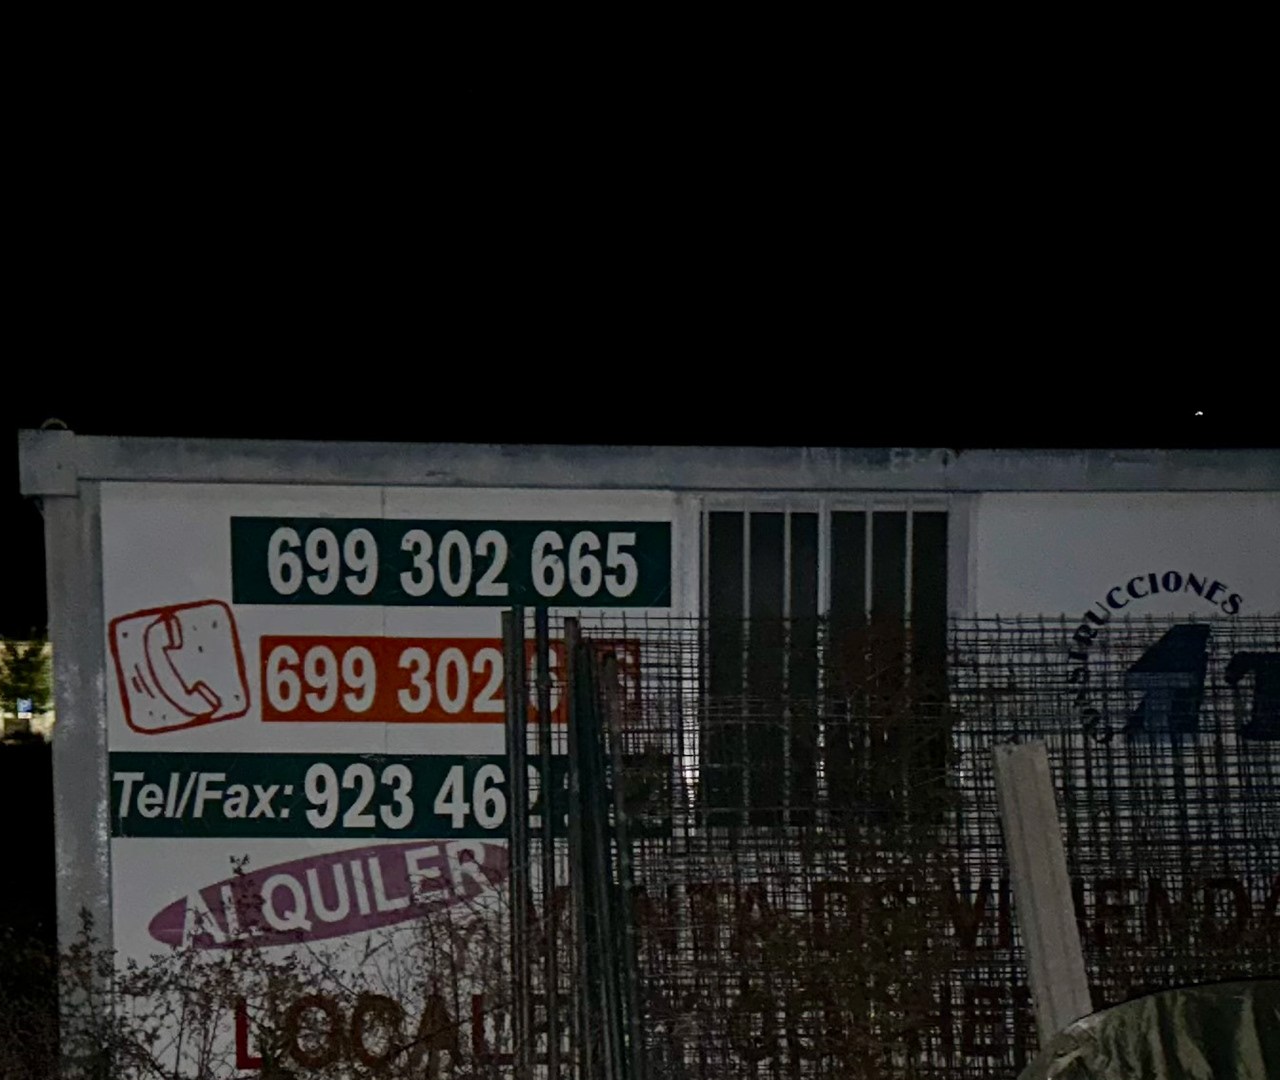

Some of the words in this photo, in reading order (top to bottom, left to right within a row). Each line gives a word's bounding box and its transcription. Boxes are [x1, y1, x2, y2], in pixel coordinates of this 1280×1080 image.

[266, 526, 379, 596] 699
[399, 527, 509, 598] 302
[531, 530, 639, 599] 665
[264, 644, 378, 714] 699
[396, 645, 505, 715] 302
[112, 771, 293, 820] Tel/Fax:
[303, 762, 415, 829] 923
[181, 840, 494, 949] ALQUILER
